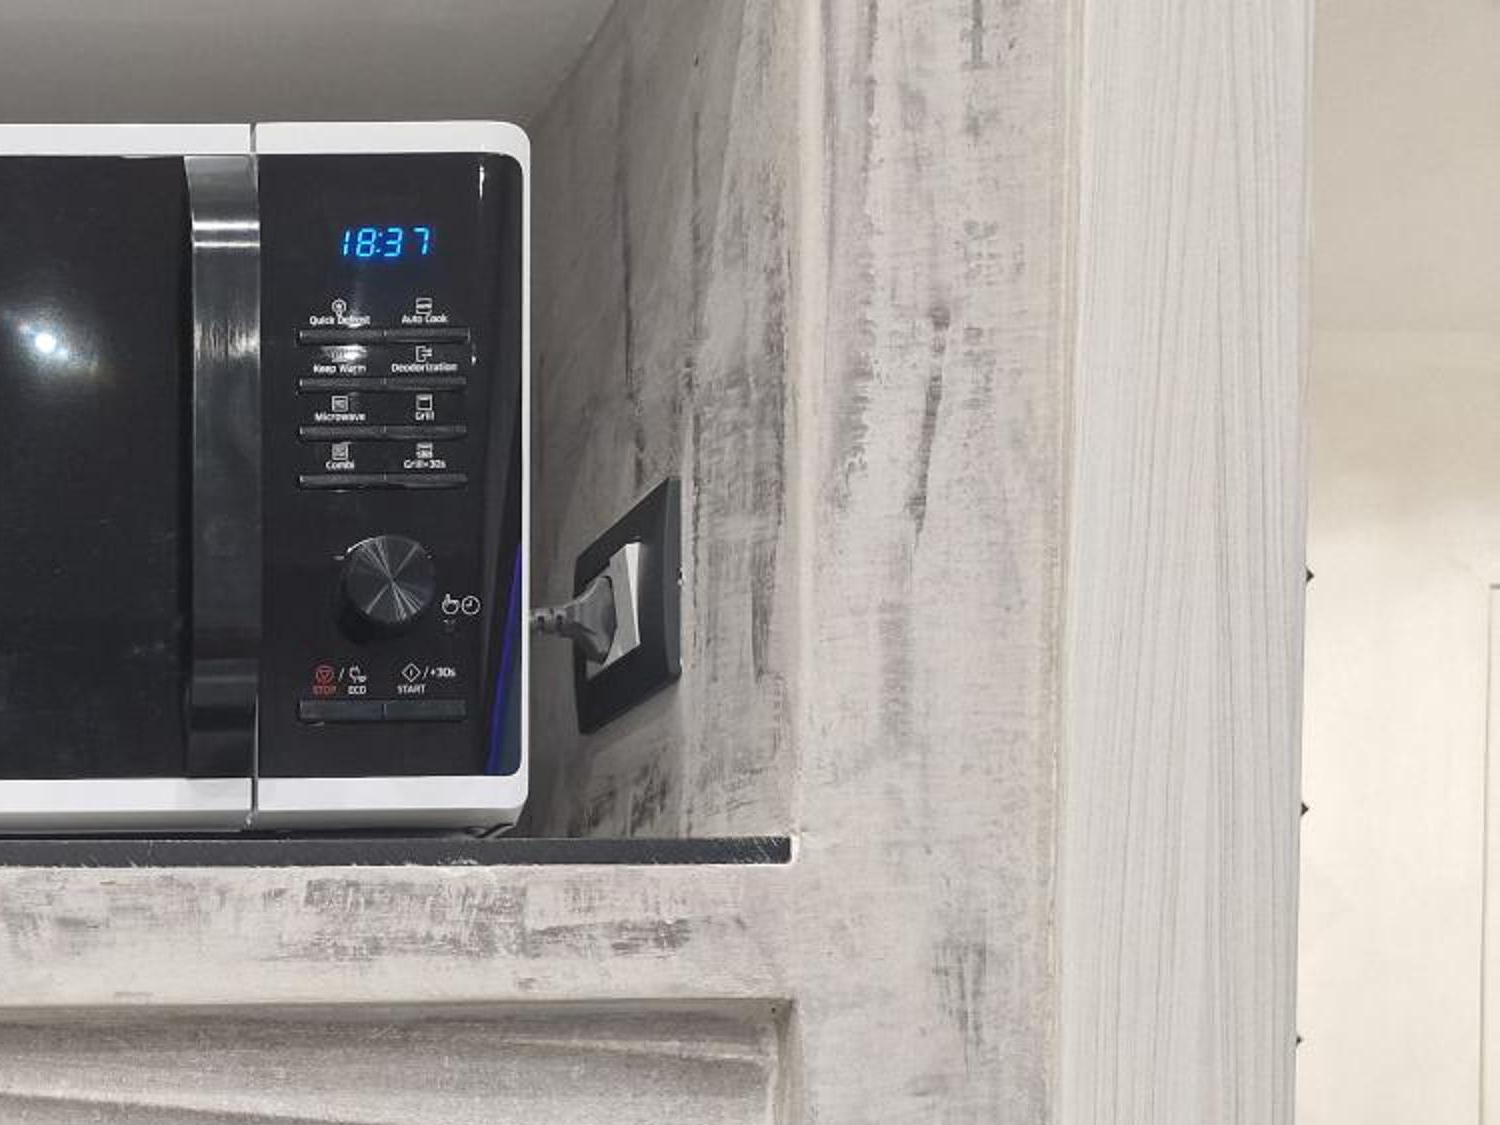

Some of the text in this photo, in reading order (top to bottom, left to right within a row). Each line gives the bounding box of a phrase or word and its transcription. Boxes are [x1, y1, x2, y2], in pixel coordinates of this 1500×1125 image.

[341, 227, 430, 257] 18:37
[309, 315, 335, 327] Quick
[401, 314, 448, 324] Auto Cook
[312, 364, 367, 374] Keep Warm
[390, 362, 459, 373] Deodorization
[313, 412, 367, 422] Microwave
[415, 411, 435, 421] Grill
[325, 460, 355, 470] Combi
[312, 685, 367, 695] STOP ECO
[397, 685, 426, 695] START
